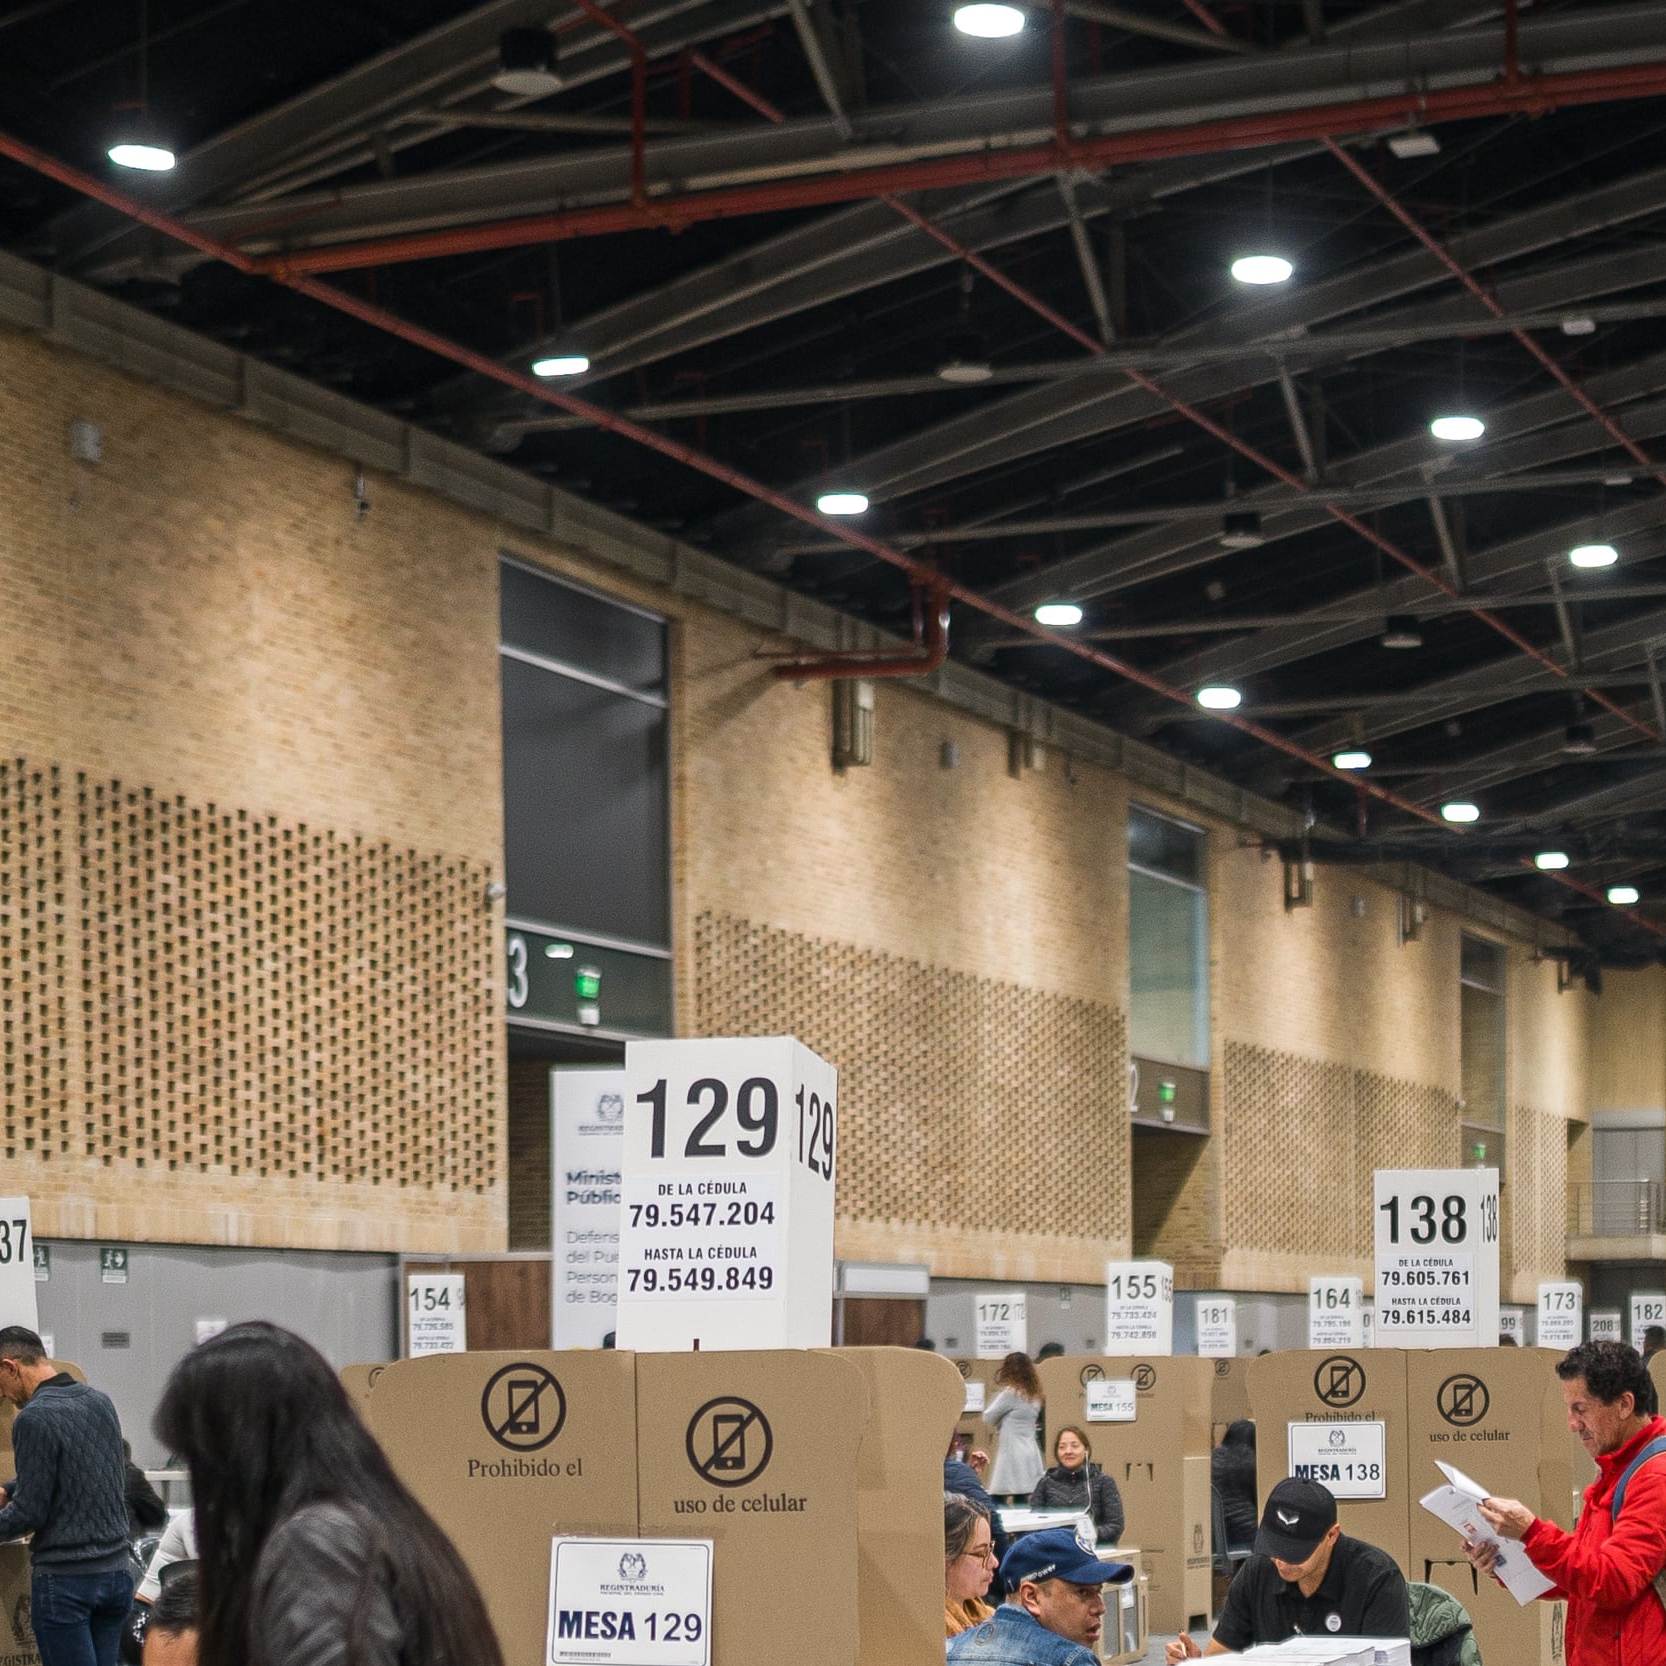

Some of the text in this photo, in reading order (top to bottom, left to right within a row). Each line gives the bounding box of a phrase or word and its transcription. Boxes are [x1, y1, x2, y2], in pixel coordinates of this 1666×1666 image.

[636, 1077, 778, 1158] 129
[795, 1083, 833, 1182] 129
[565, 1171, 622, 1186] Minist
[659, 1182, 747, 1196] DE LA CÉDULA
[566, 1191, 621, 1205] Públic
[629, 1202, 775, 1227] 79.547.204
[1381, 1195, 1467, 1244] 138
[1481, 1194, 1497, 1243] 138
[566, 1231, 619, 1244] Defens
[566, 1251, 619, 1264] del Pue
[644, 1246, 757, 1260] HASTA LA CÉDULA
[1423, 1257, 1453, 1267] CÉDULA
[566, 1272, 617, 1284] Person
[627, 1266, 773, 1292] 79.549.849
[1382, 1271, 1469, 1286] 79.605.761
[1112, 1275, 1156, 1300] 155
[410, 1287, 450, 1311] 154
[566, 1291, 617, 1306] de Bog
[1313, 1288, 1350, 1309] 164
[1431, 1295, 1460, 1305] CÉDULA
[1544, 1292, 1575, 1310] 173
[979, 1303, 1010, 1321] 172
[1202, 1308, 1228, 1324] 181
[1382, 1310, 1470, 1324] 79.615.484
[1634, 1304, 1663, 1320] 182
[1593, 1320, 1613, 1332] 208
[1091, 1403, 1133, 1412] MESA 155
[1306, 1412, 1375, 1422] Prohibido el
[1429, 1429, 1510, 1442] uso de celular
[467, 1457, 583, 1479] Prohibido el
[1295, 1464, 1380, 1481] MESA 138
[673, 1493, 807, 1515] uso de celular
[600, 1583, 665, 1593] REGISTRADURÍA
[558, 1611, 702, 1643] MESA 129
